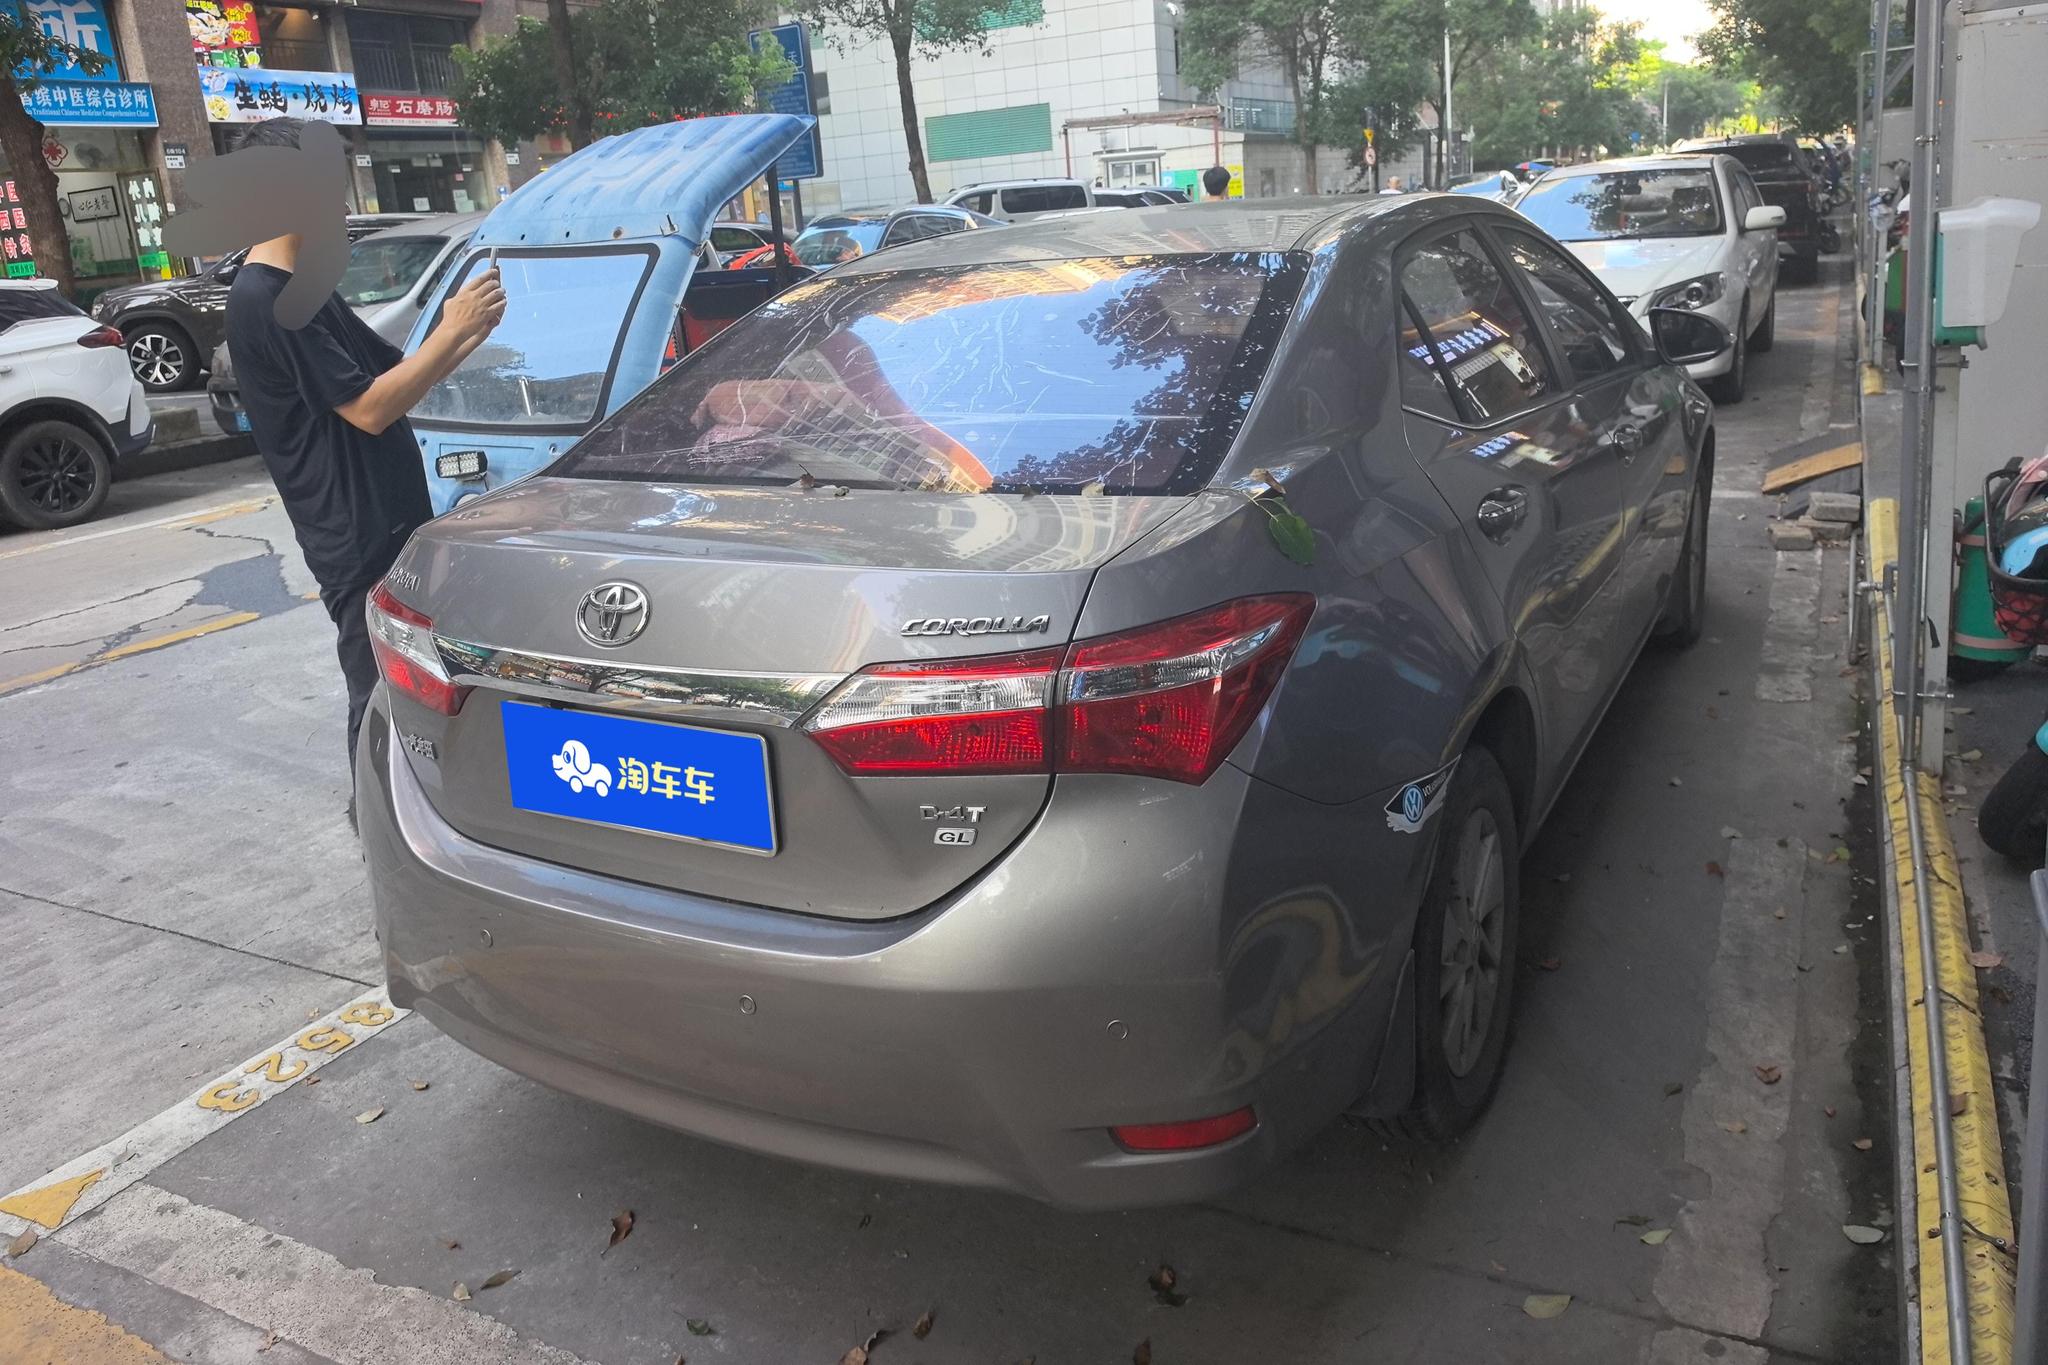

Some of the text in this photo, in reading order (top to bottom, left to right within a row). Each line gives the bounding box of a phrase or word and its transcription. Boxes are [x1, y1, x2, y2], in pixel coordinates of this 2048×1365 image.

[32, 108, 61, 116] Traditional
[102, 109, 137, 118] Comprehensive
[900, 615, 1050, 636] COROLLA
[938, 832, 969, 843] GL
[197, 1002, 395, 1112] 8523
